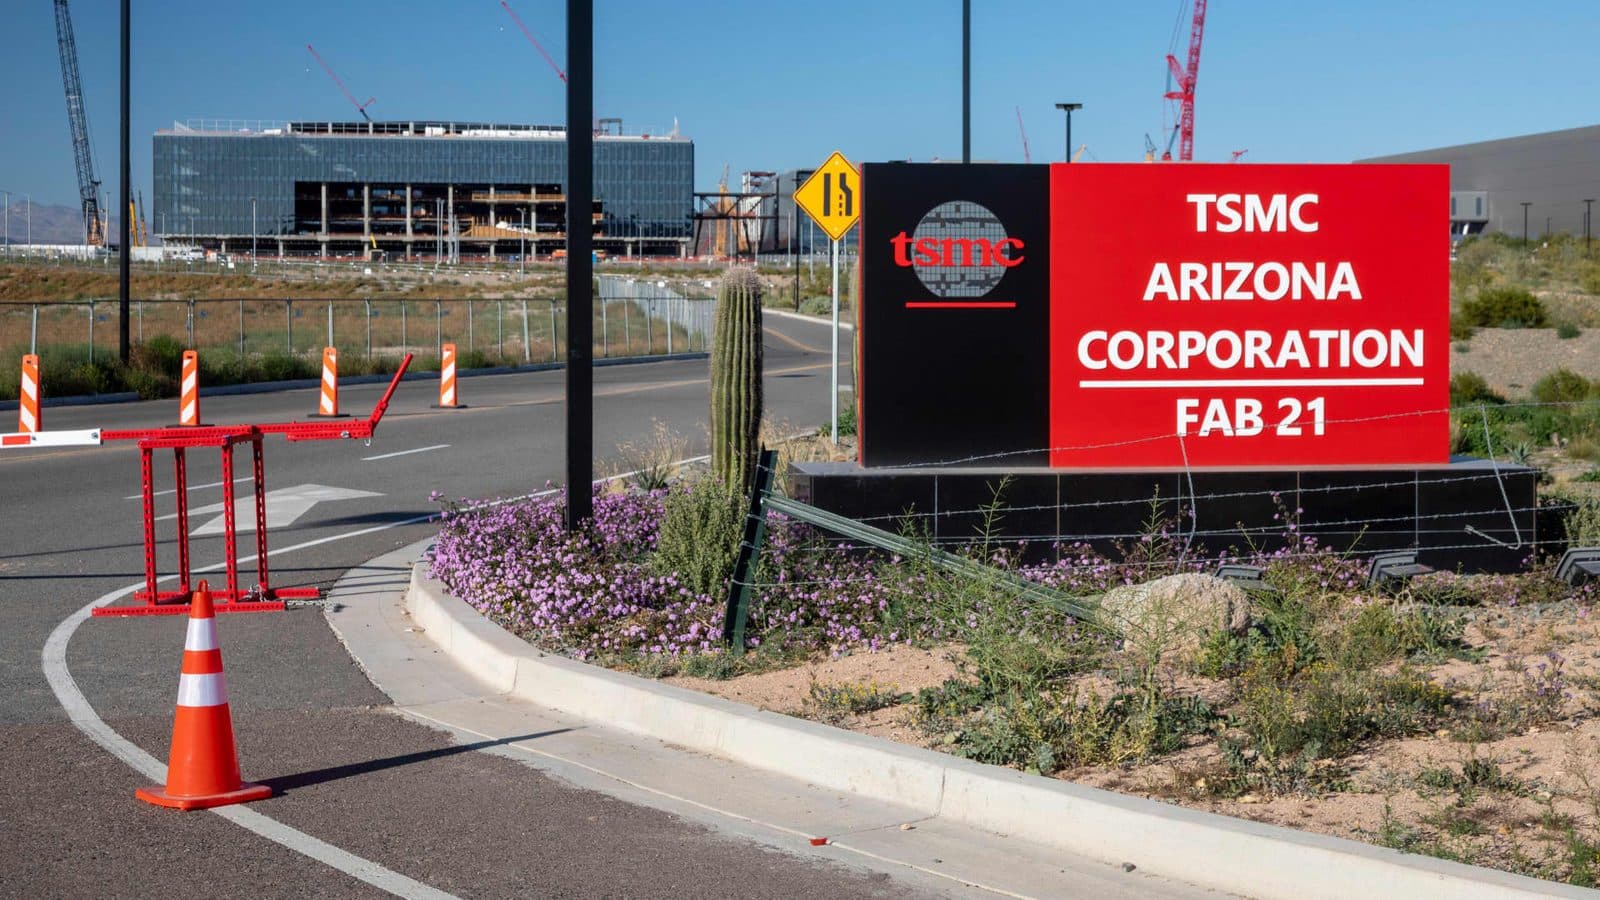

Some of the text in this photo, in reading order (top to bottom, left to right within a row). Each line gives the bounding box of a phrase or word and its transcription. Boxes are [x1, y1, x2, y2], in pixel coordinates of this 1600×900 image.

[1186, 193, 1319, 233] TSMC
[890, 231, 1024, 268] tsmc
[1142, 261, 1362, 301] ARIZONA
[1077, 328, 1424, 370] CORPORATION
[1176, 396, 1325, 437] FAB 21
